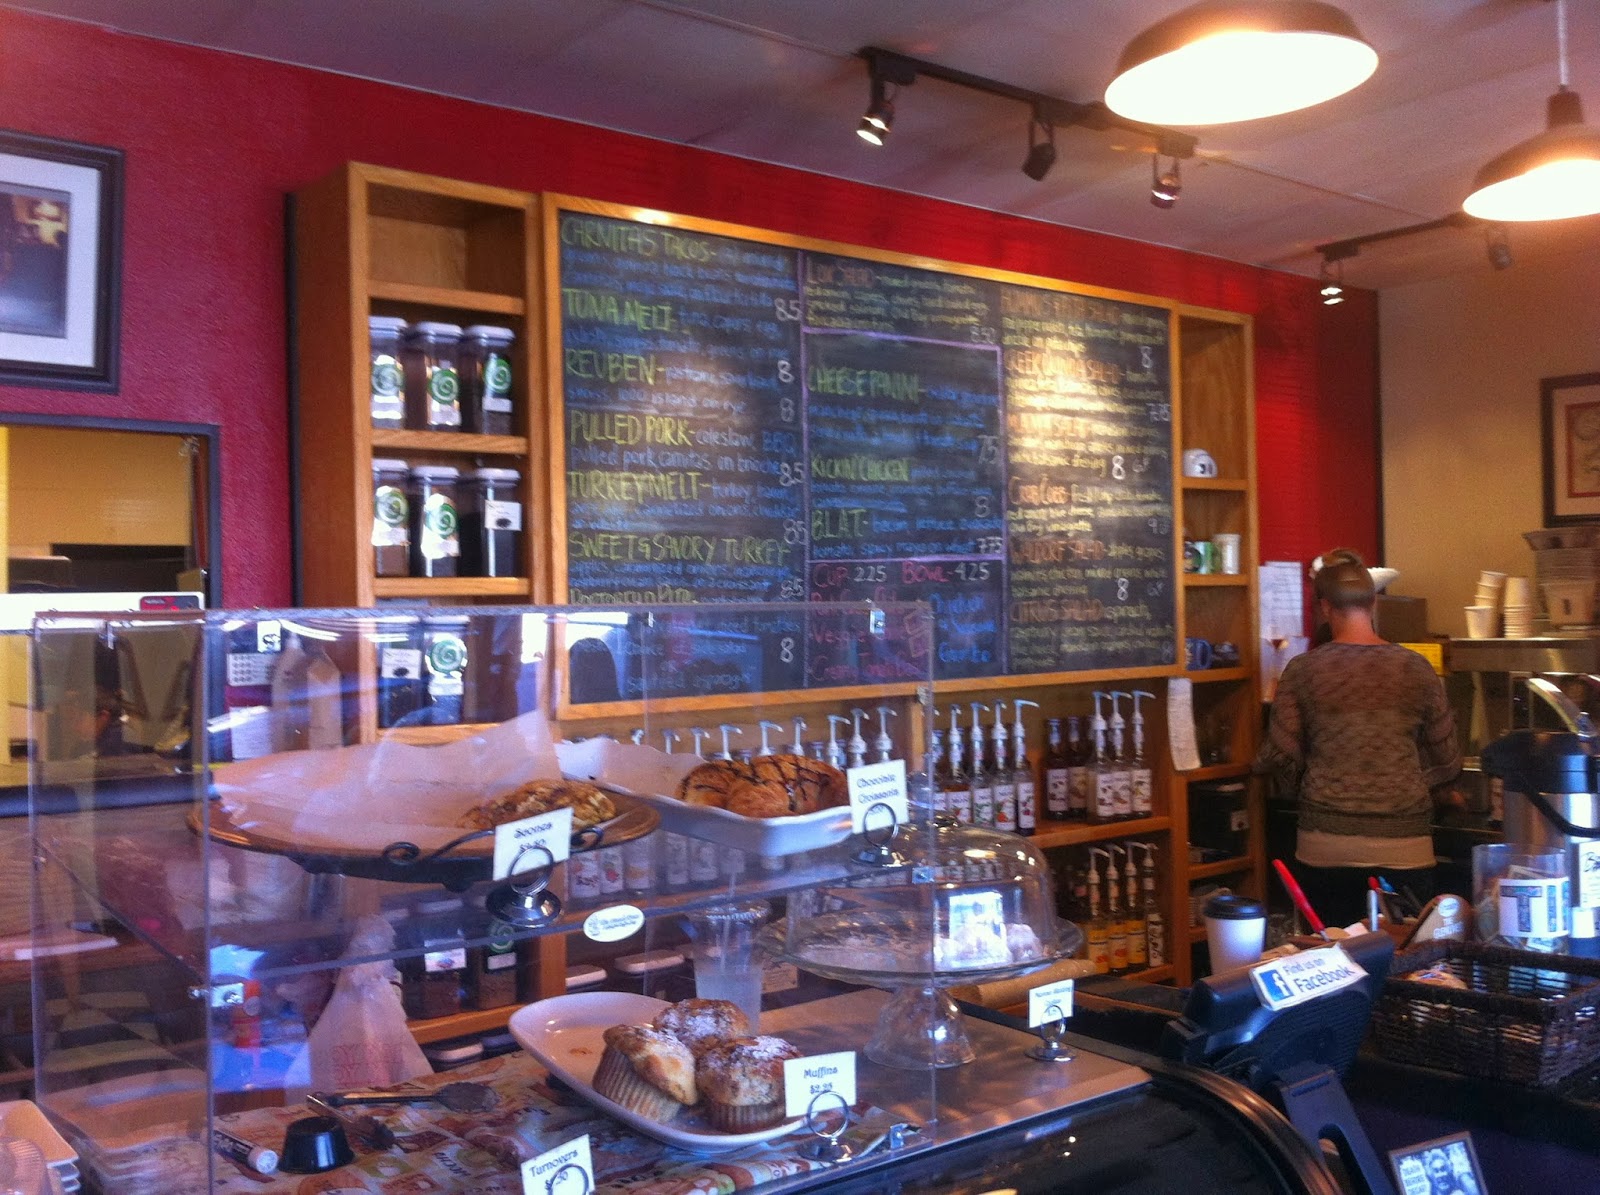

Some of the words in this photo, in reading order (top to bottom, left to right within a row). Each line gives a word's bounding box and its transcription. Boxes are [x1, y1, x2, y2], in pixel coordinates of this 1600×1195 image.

[562, 288, 619, 325] TUNA
[1139, 345, 1154, 369] 8
[777, 360, 795, 383] 8
[780, 398, 795, 423] 8
[570, 410, 642, 446] PULLED
[1112, 454, 1126, 481] 8
[974, 495, 991, 519] 8
[568, 531, 639, 562] SWEET
[652, 532, 717, 567] SAVORY
[1117, 577, 1130, 602] 8
[779, 637, 795, 664] 8
[1293, 965, 1356, 993] Facebook
[804, 1066, 838, 1079] Muffins
[529, 1149, 579, 1178] Turnovers
